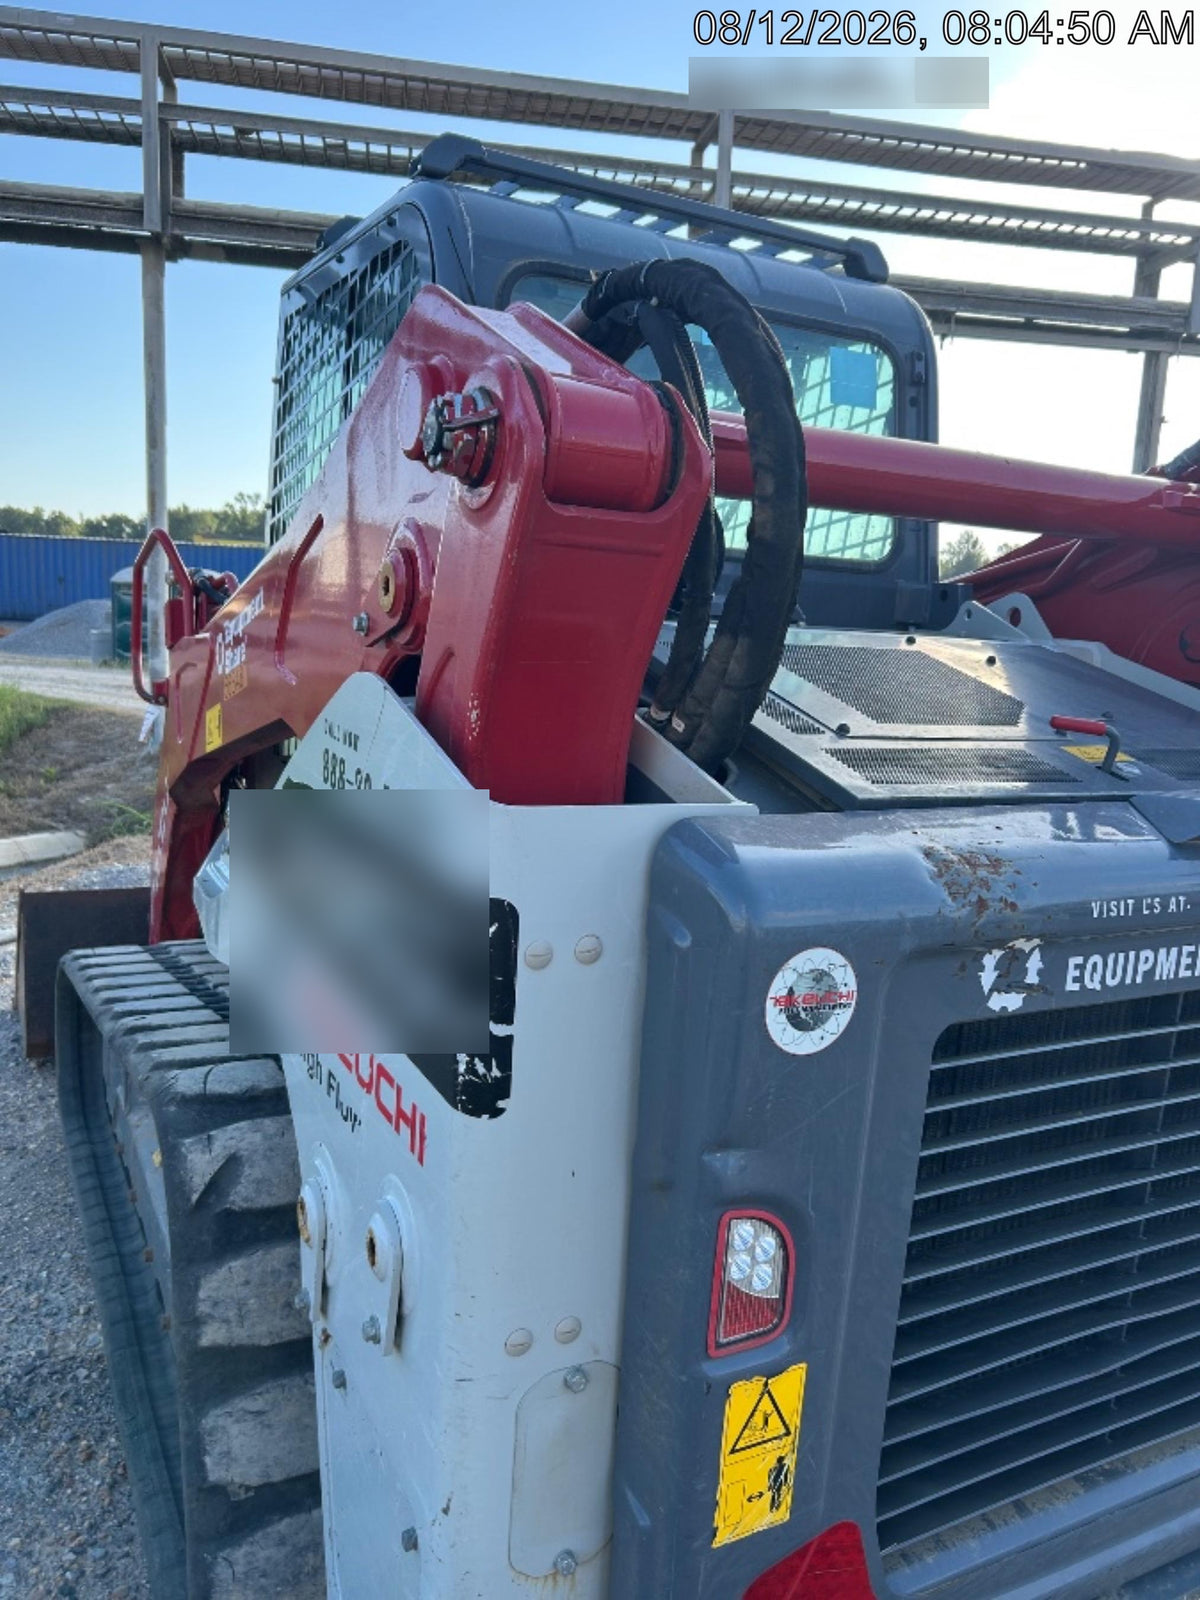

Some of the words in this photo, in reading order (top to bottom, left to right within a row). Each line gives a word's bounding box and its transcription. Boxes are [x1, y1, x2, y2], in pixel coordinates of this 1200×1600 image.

[1091, 899, 1135, 918] VISIT
[1065, 944, 1200, 991] EQUIPME
[337, 1053, 427, 1168] UCHI
